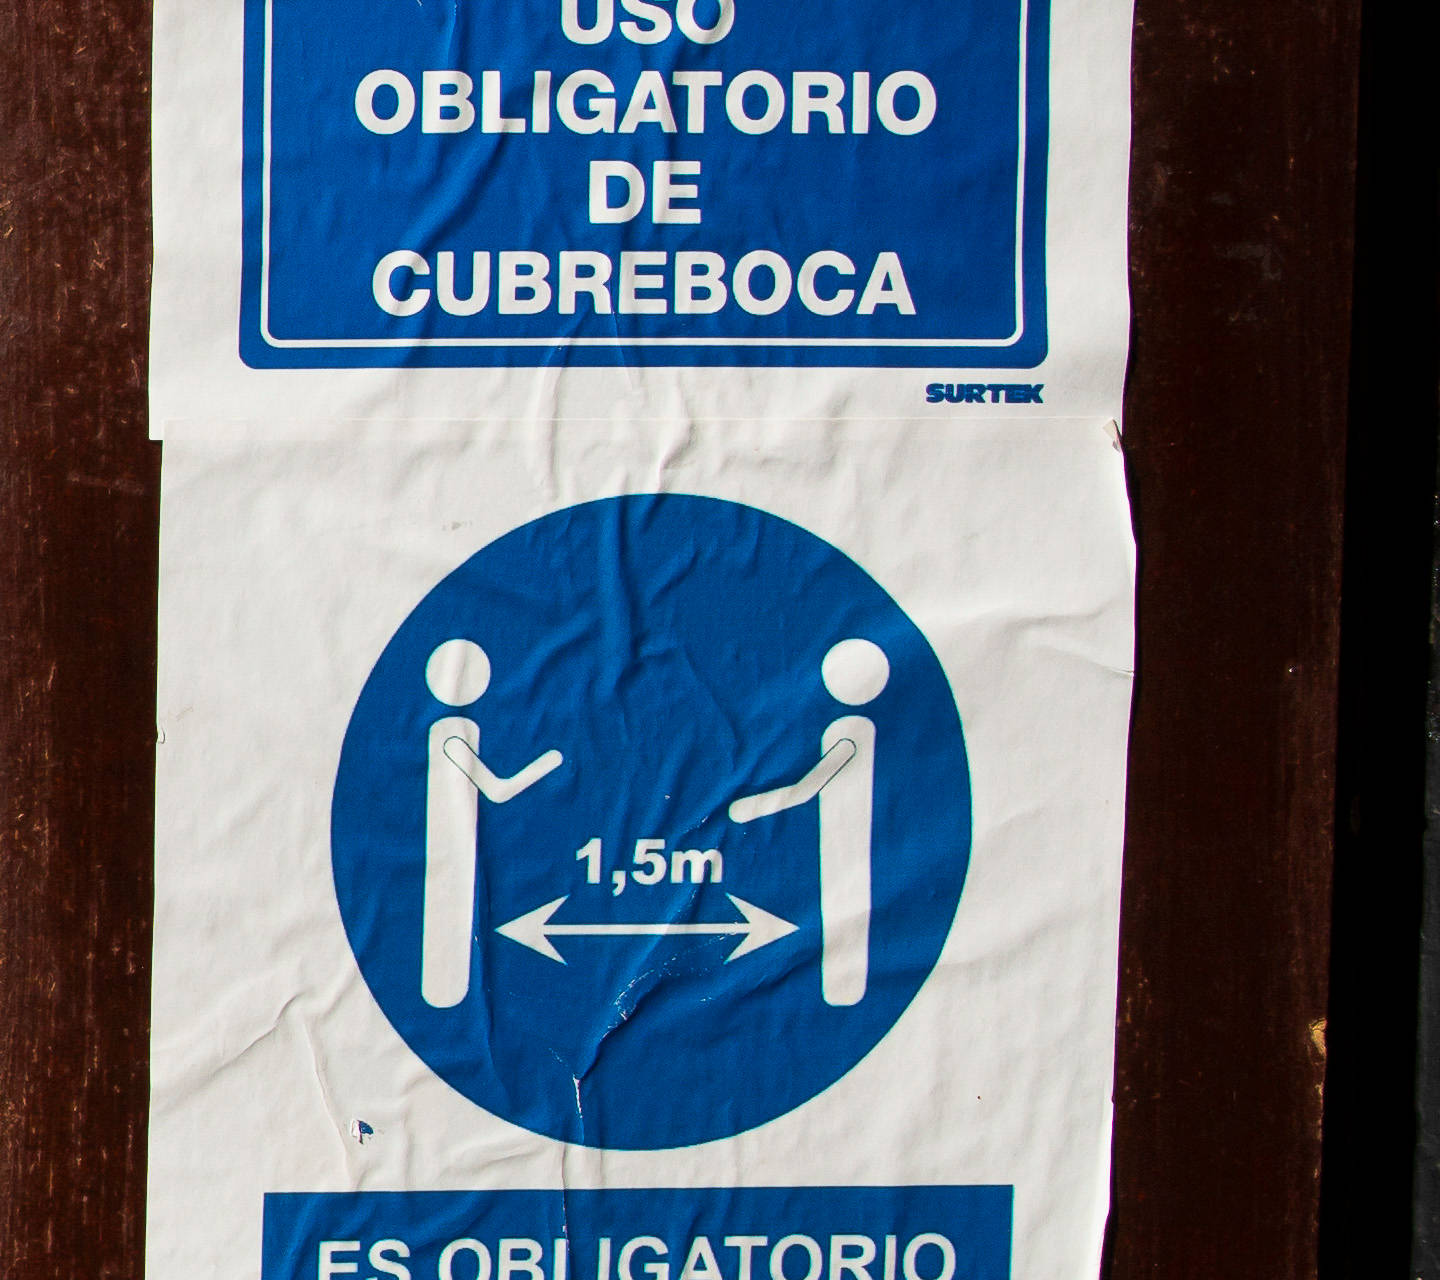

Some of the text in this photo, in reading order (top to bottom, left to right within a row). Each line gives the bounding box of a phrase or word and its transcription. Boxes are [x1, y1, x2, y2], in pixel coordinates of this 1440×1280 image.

[354, 69, 937, 136] OBLIGATORIO
[589, 160, 702, 224] DE
[372, 249, 917, 317] CUBREBOCA
[926, 383, 1044, 404] SURTEK
[576, 837, 723, 897] 1,5m
